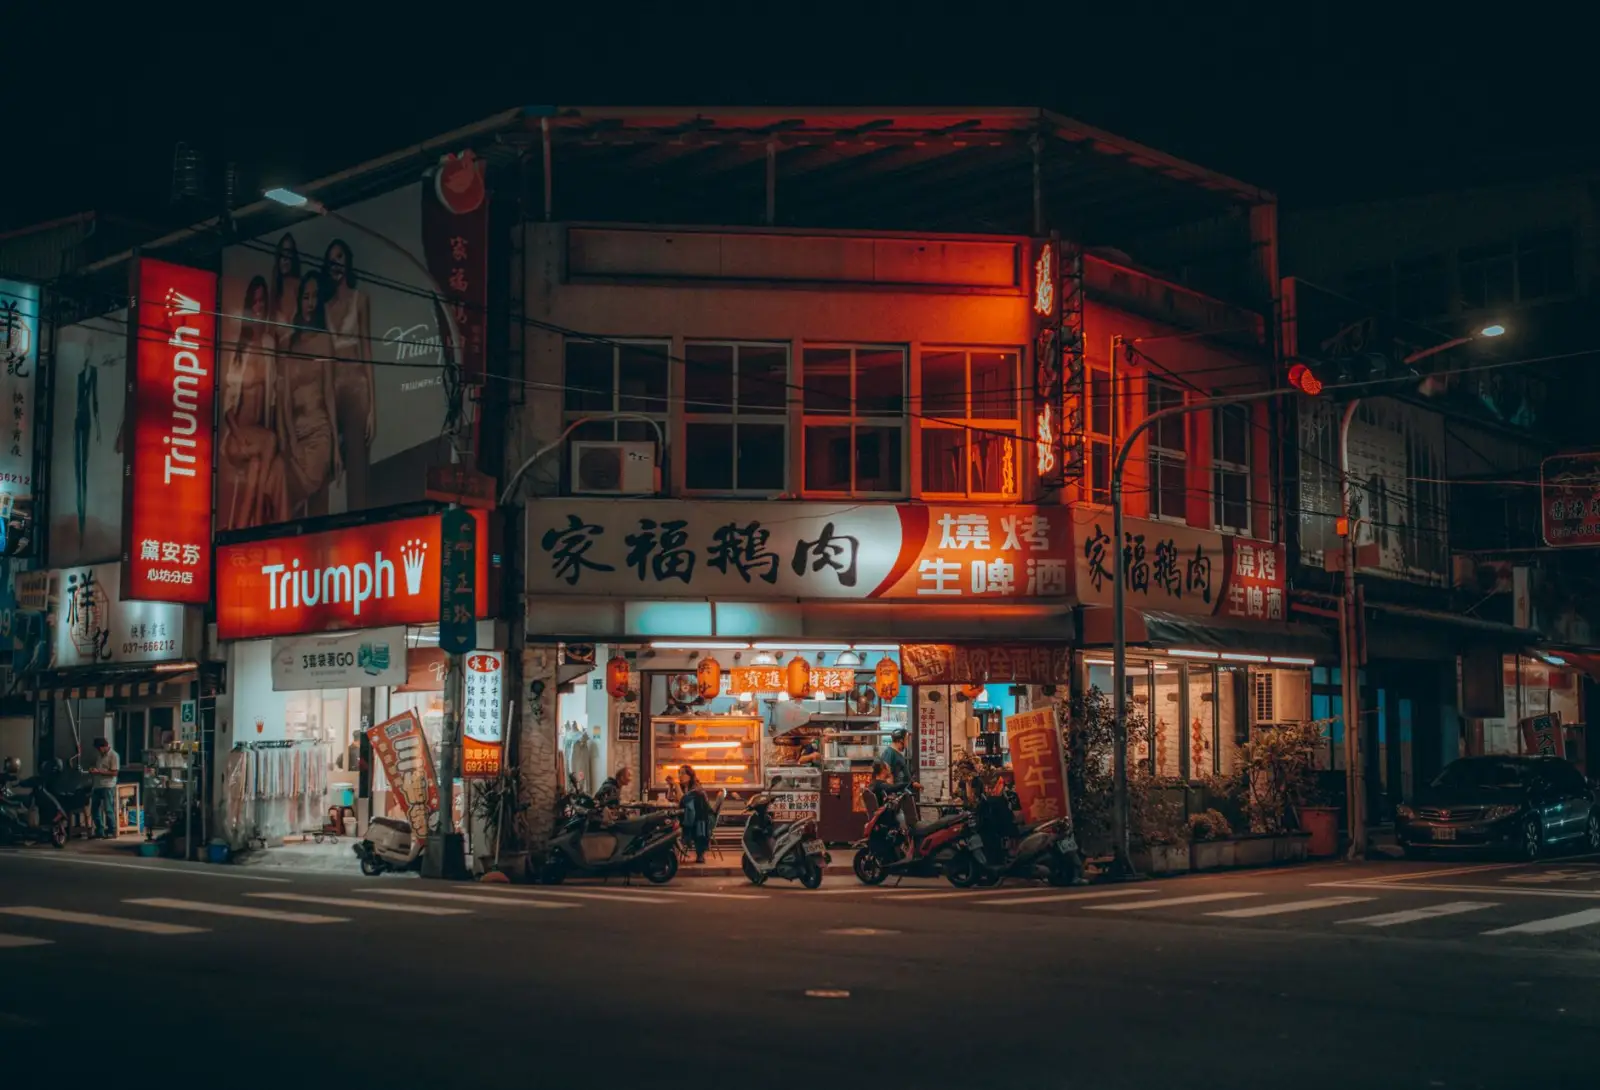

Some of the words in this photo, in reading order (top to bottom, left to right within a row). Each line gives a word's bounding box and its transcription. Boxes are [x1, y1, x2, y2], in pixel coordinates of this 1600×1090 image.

[164, 326, 207, 484] Triumph
[541, 514, 860, 587] 家福鵝肉
[937, 512, 1050, 551] 燒烤
[140, 539, 201, 565] 黛安芬
[1084, 523, 1212, 605] 家福鵝肉
[1236, 543, 1277, 581] 燒烤
[262, 551, 395, 615] Triumph
[917, 557, 1067, 596] 生啤酒
[1229, 583, 1282, 620] 生啤酒
